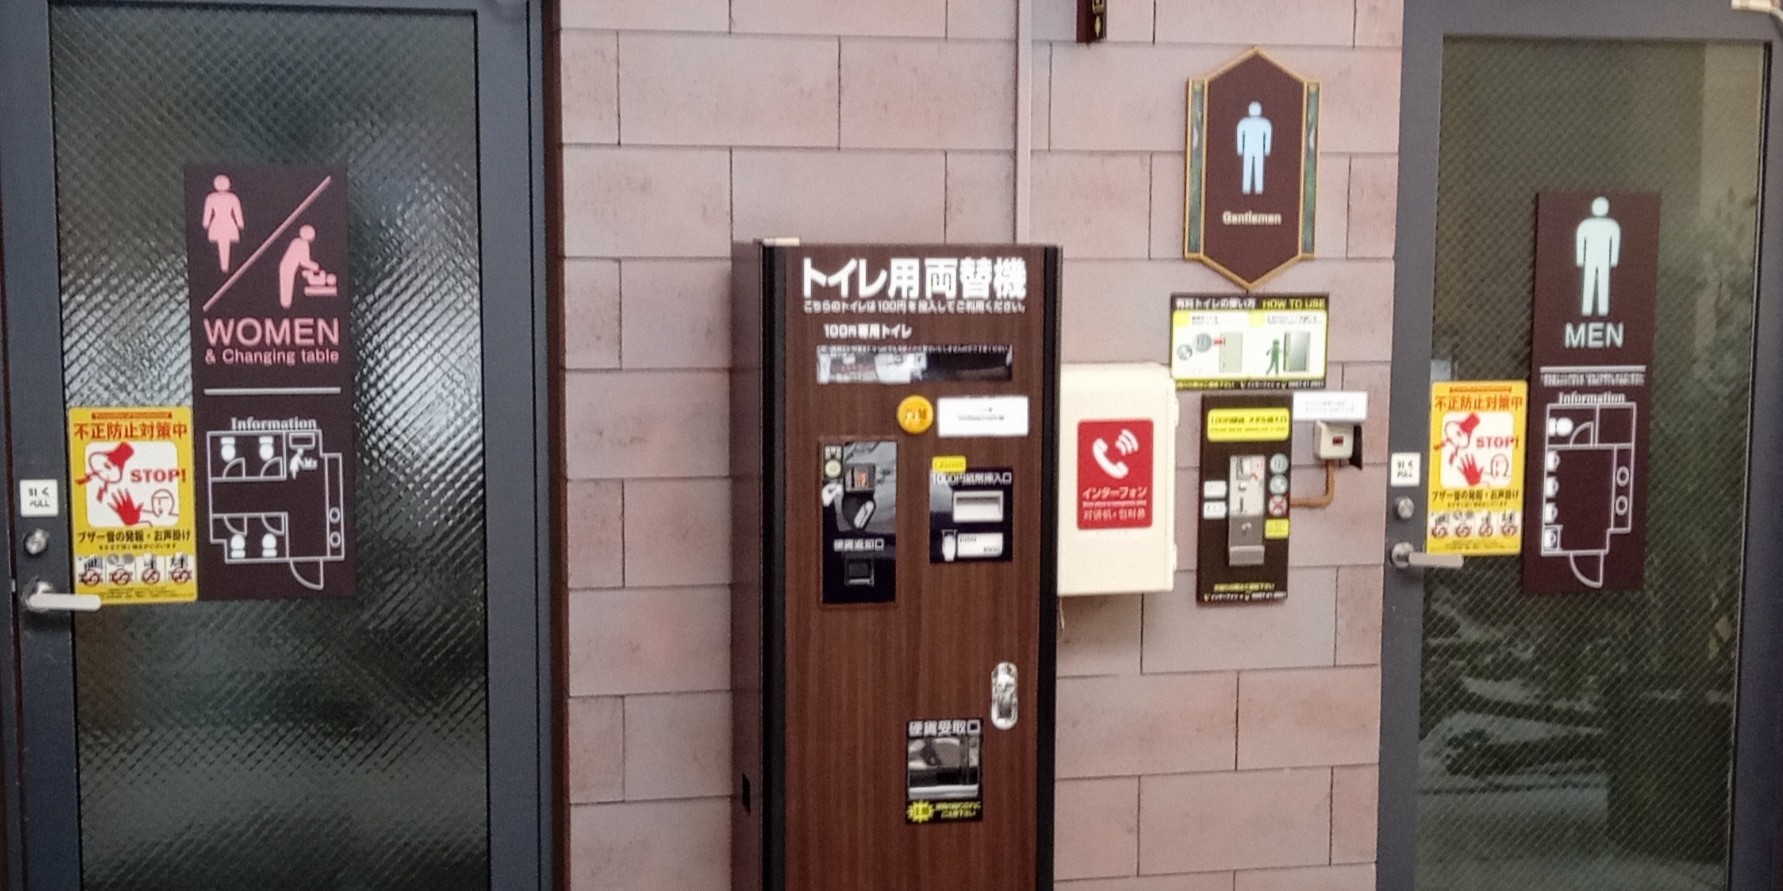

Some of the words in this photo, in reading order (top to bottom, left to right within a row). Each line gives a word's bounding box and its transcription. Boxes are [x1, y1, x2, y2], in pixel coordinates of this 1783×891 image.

[1223, 210, 1282, 226] Gentlemen
[803, 257, 1027, 300] トイレ用両替機
[1262, 299, 1288, 309] HOW
[1290, 299, 1303, 309] TO
[1304, 298, 1326, 308] USE
[203, 317, 340, 347] WOMEN
[1564, 322, 1624, 349] MEN
[205, 348, 216, 365] &
[222, 348, 296, 367] Changing
[301, 348, 339, 364] table
[1434, 395, 1523, 412] 不正防止対策中
[1558, 390, 1626, 404] Information
[74, 421, 188, 440] 不正防止対策中
[231, 416, 317, 431] Information
[1475, 435, 1519, 449] STOP!
[130, 468, 187, 483] STOP!
[1082, 486, 1148, 501] インターフォン
[908, 720, 981, 737] 硬貨受取口
